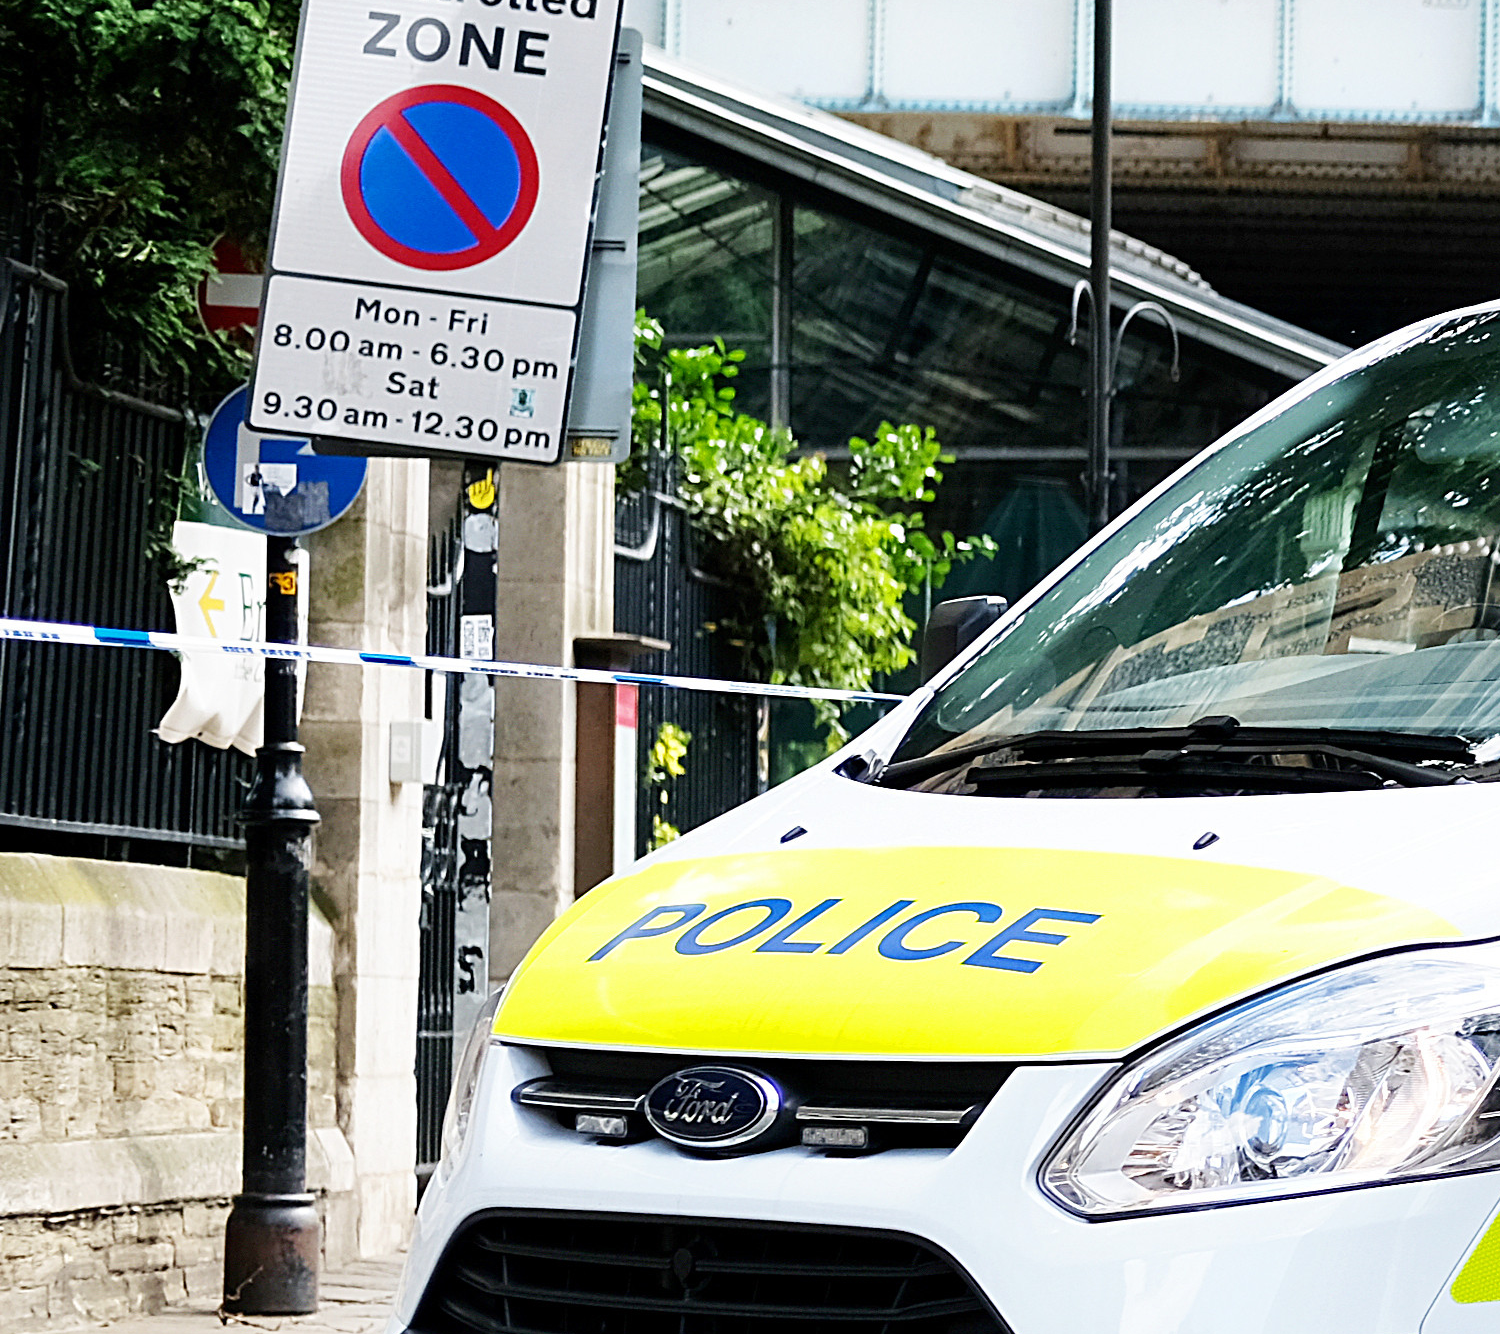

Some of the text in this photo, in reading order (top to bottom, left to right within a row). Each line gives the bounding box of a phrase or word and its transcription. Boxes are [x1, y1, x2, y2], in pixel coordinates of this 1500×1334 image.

[362, 10, 550, 77] ZONE
[354, 297, 421, 327] Mon
[448, 308, 489, 336] Fri
[273, 323, 351, 352] 8.00
[357, 337, 403, 361] am
[429, 341, 505, 373] 6.30
[511, 356, 559, 380] pm
[385, 370, 441, 400] Sat
[262, 391, 338, 421] 9.30
[343, 405, 389, 429] am
[411, 409, 499, 443] 12.30
[503, 426, 551, 449] pm
[588, 897, 1103, 975] POLICE
[663, 1076, 740, 1126] Ford
